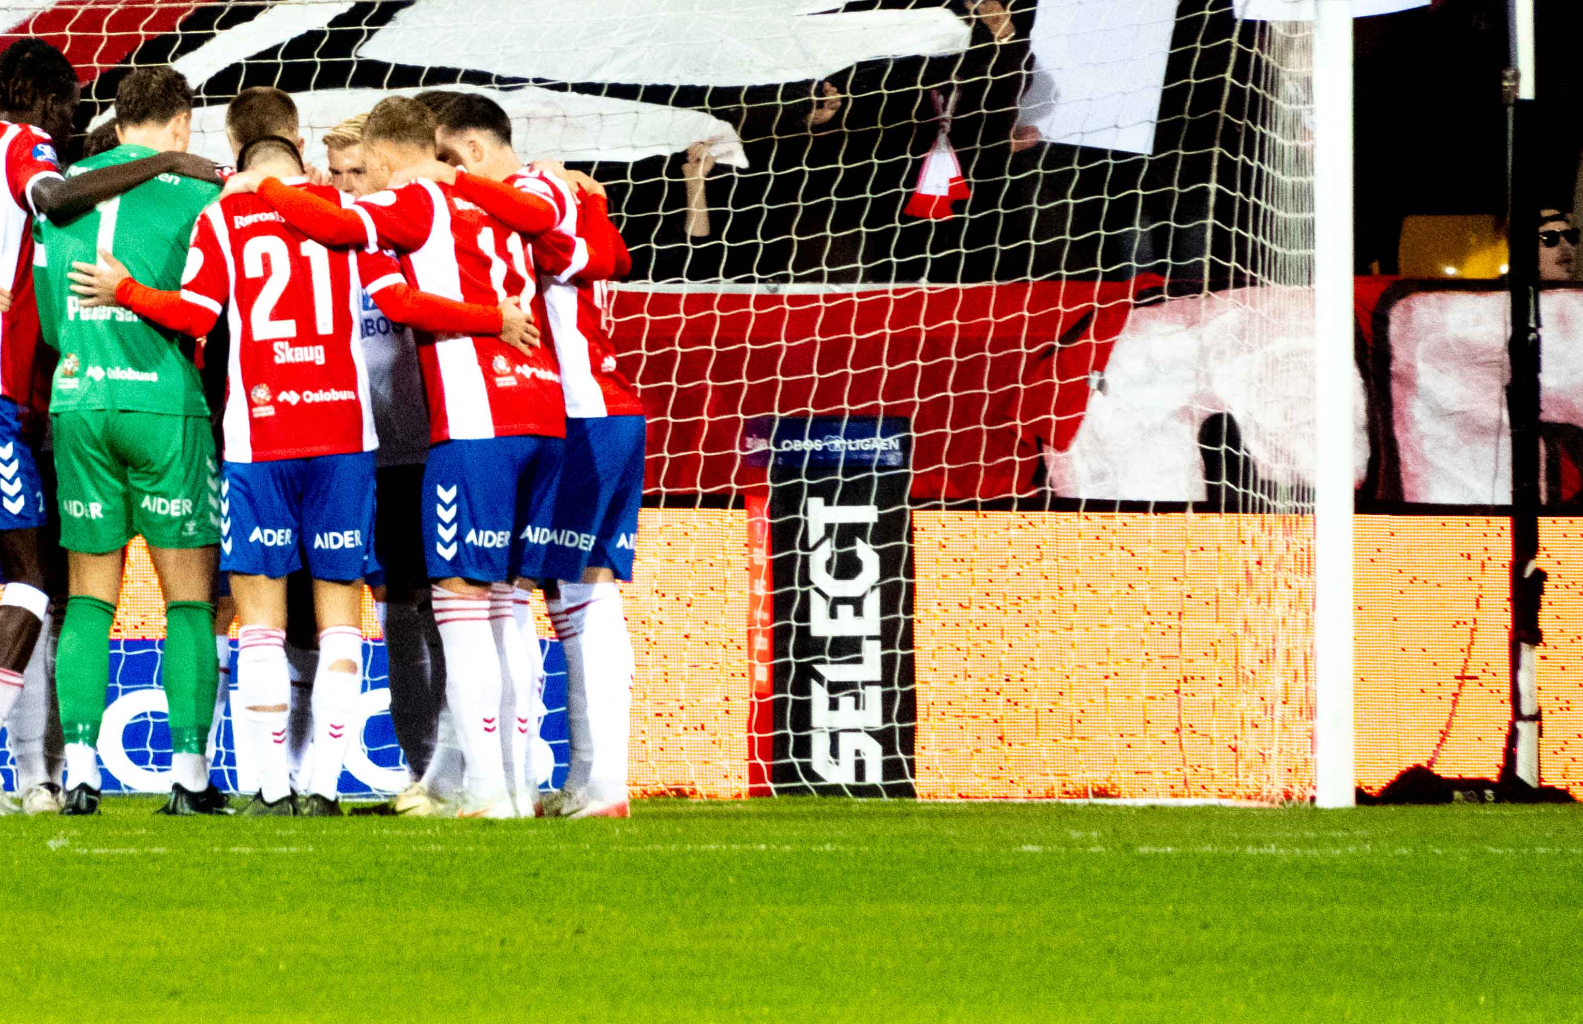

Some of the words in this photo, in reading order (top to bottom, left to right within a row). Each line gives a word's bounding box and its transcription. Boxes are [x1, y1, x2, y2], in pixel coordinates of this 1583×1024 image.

[243, 235, 333, 341] 21
[273, 341, 325, 365] Skaug
[848, 438, 900, 451] LIGAEN
[141, 495, 193, 517] AIDER
[249, 526, 292, 547] ADER
[314, 529, 363, 549] AIDER
[808, 497, 883, 784] SELECT
